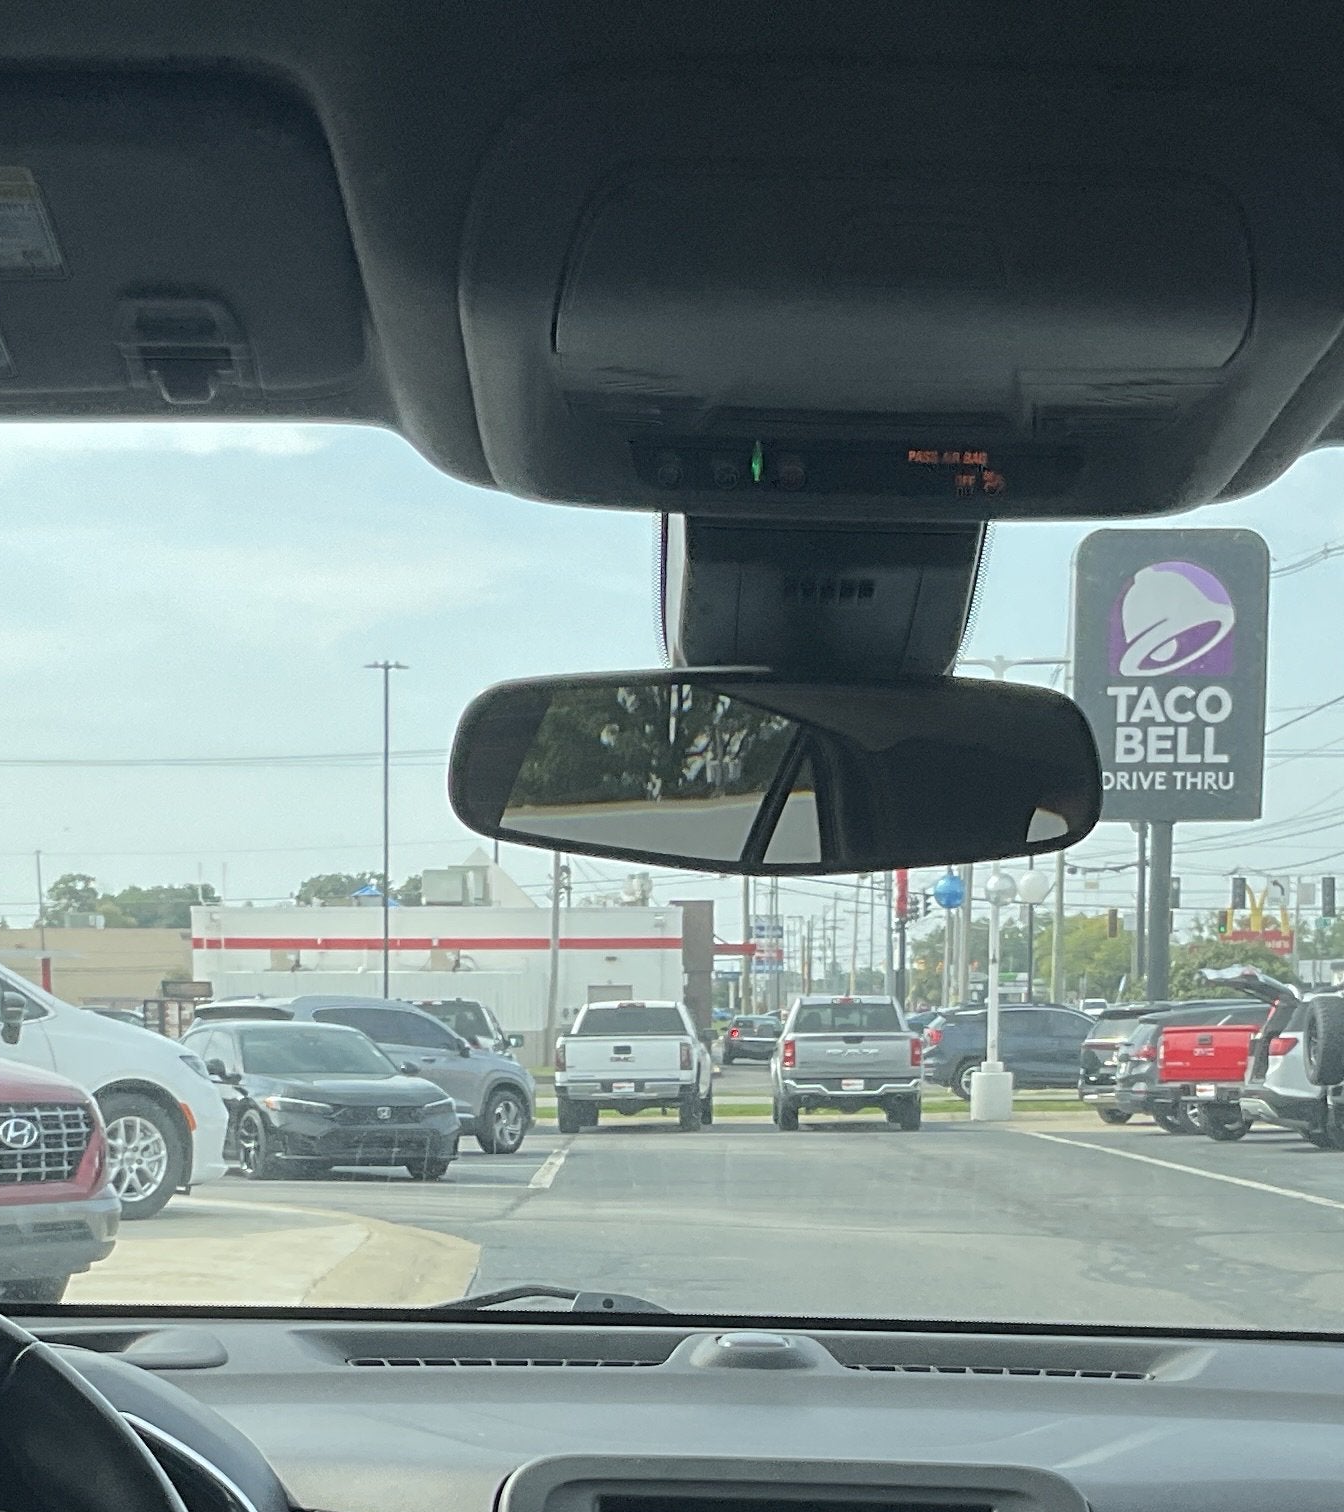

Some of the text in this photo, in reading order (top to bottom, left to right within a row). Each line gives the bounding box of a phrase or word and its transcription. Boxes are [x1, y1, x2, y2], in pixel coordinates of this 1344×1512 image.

[1107, 686, 1233, 723] TACO
[1115, 727, 1230, 763] BELL
[1102, 771, 1234, 790] DRIVE THRU
